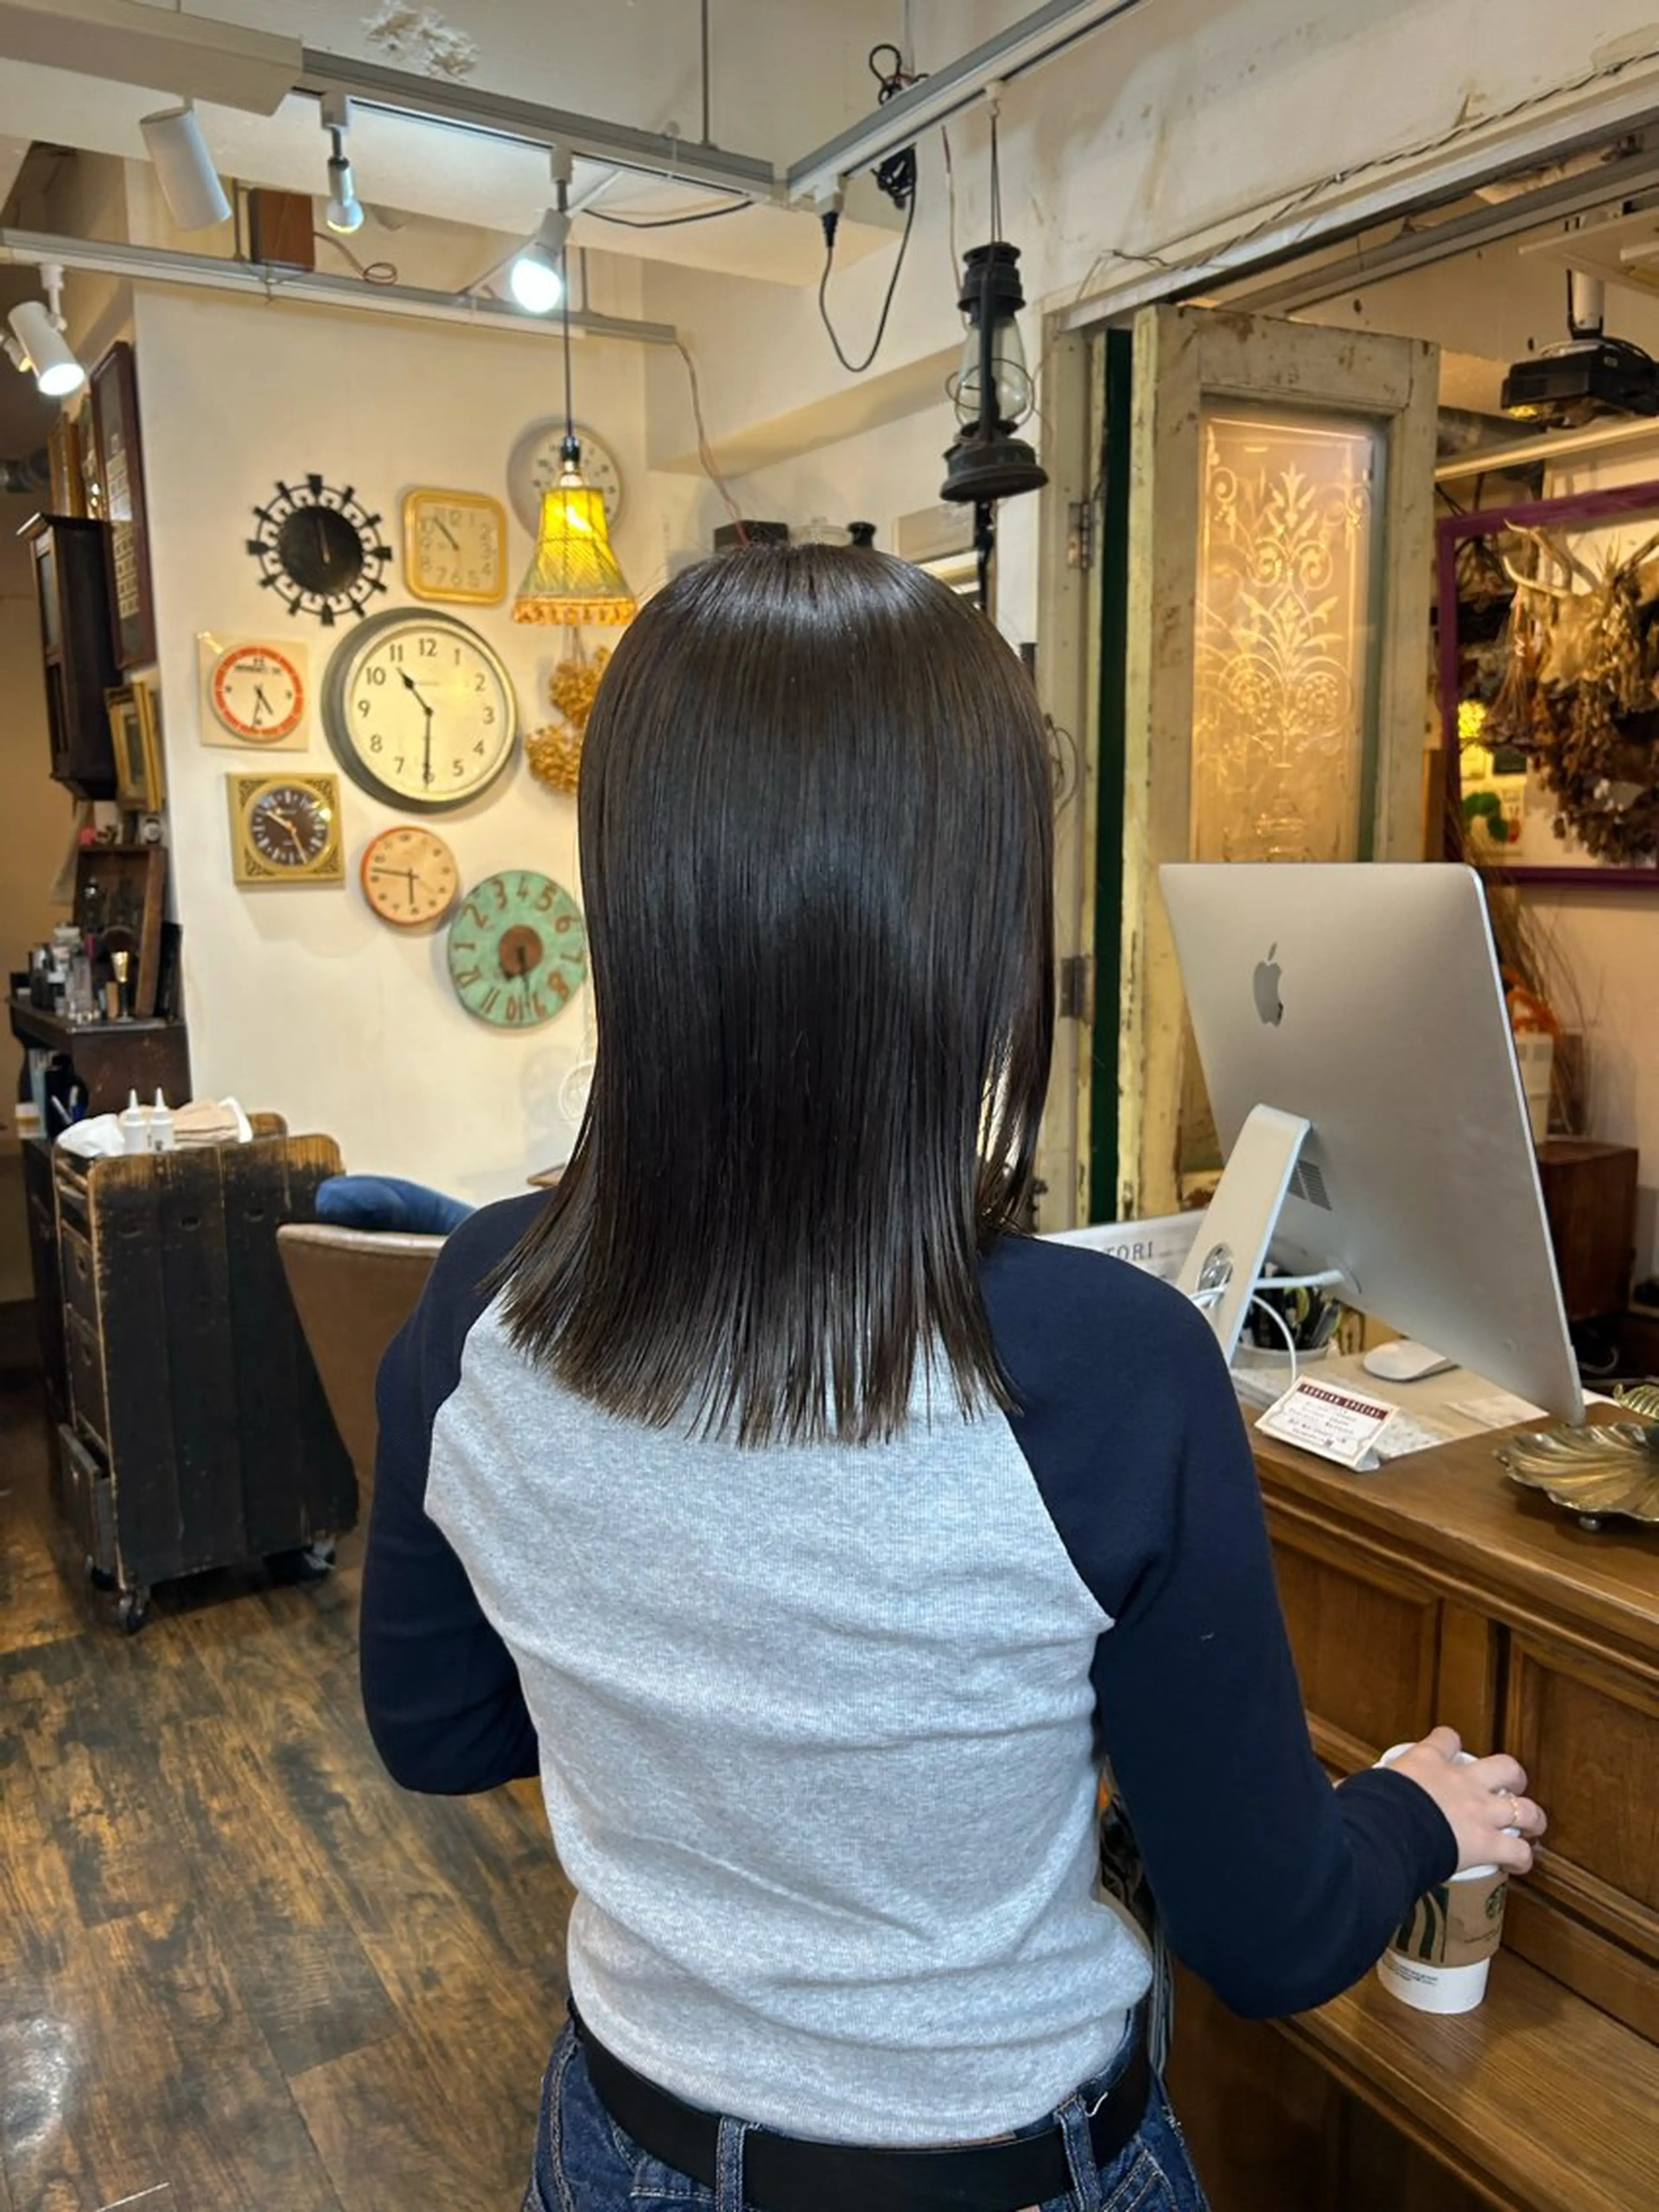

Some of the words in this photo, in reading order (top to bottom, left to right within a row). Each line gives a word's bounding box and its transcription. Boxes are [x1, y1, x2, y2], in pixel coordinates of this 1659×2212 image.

[389, 644, 403, 662] 11
[419, 638, 437, 657] 12
[454, 648, 461, 665] 1
[366, 667, 386, 686] 10
[475, 672, 485, 692] 2
[358, 699, 371, 718] 9
[483, 706, 495, 725] 3
[370, 734, 383, 753] 8
[474, 739, 485, 755] 4
[394, 756, 404, 774] 7
[453, 759, 464, 777] 5
[492, 878, 508, 910] 3
[516, 874, 529, 902] 4
[535, 880, 558, 913] 5
[461, 903, 491, 930] 2
[555, 915, 582, 934] 6
[548, 969, 570, 1003] 8
[479, 987, 500, 1014] 11
